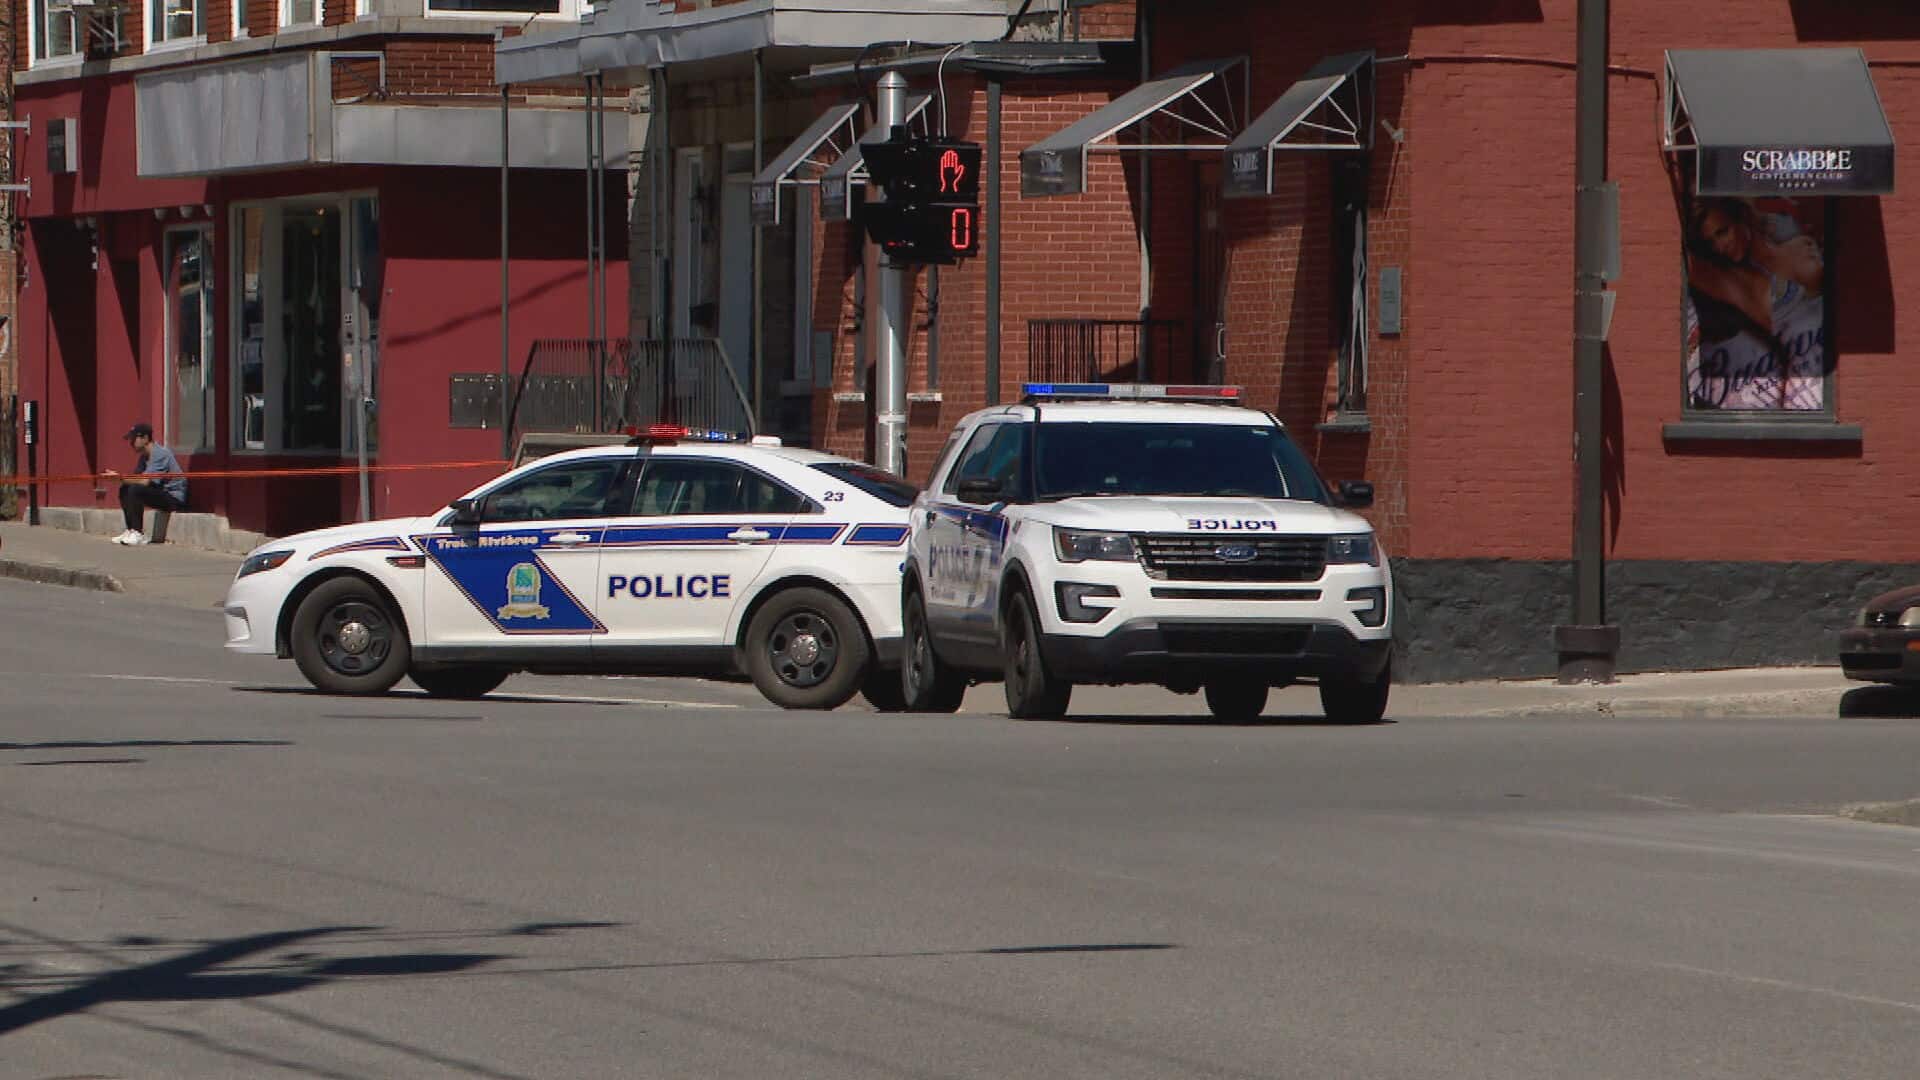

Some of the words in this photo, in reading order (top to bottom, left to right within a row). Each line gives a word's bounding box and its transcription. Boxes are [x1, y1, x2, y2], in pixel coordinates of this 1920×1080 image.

[1742, 150, 1852, 170] SCRABBLE
[951, 208, 971, 249] 0
[823, 491, 844, 502] 23
[608, 575, 731, 598] POLICE
